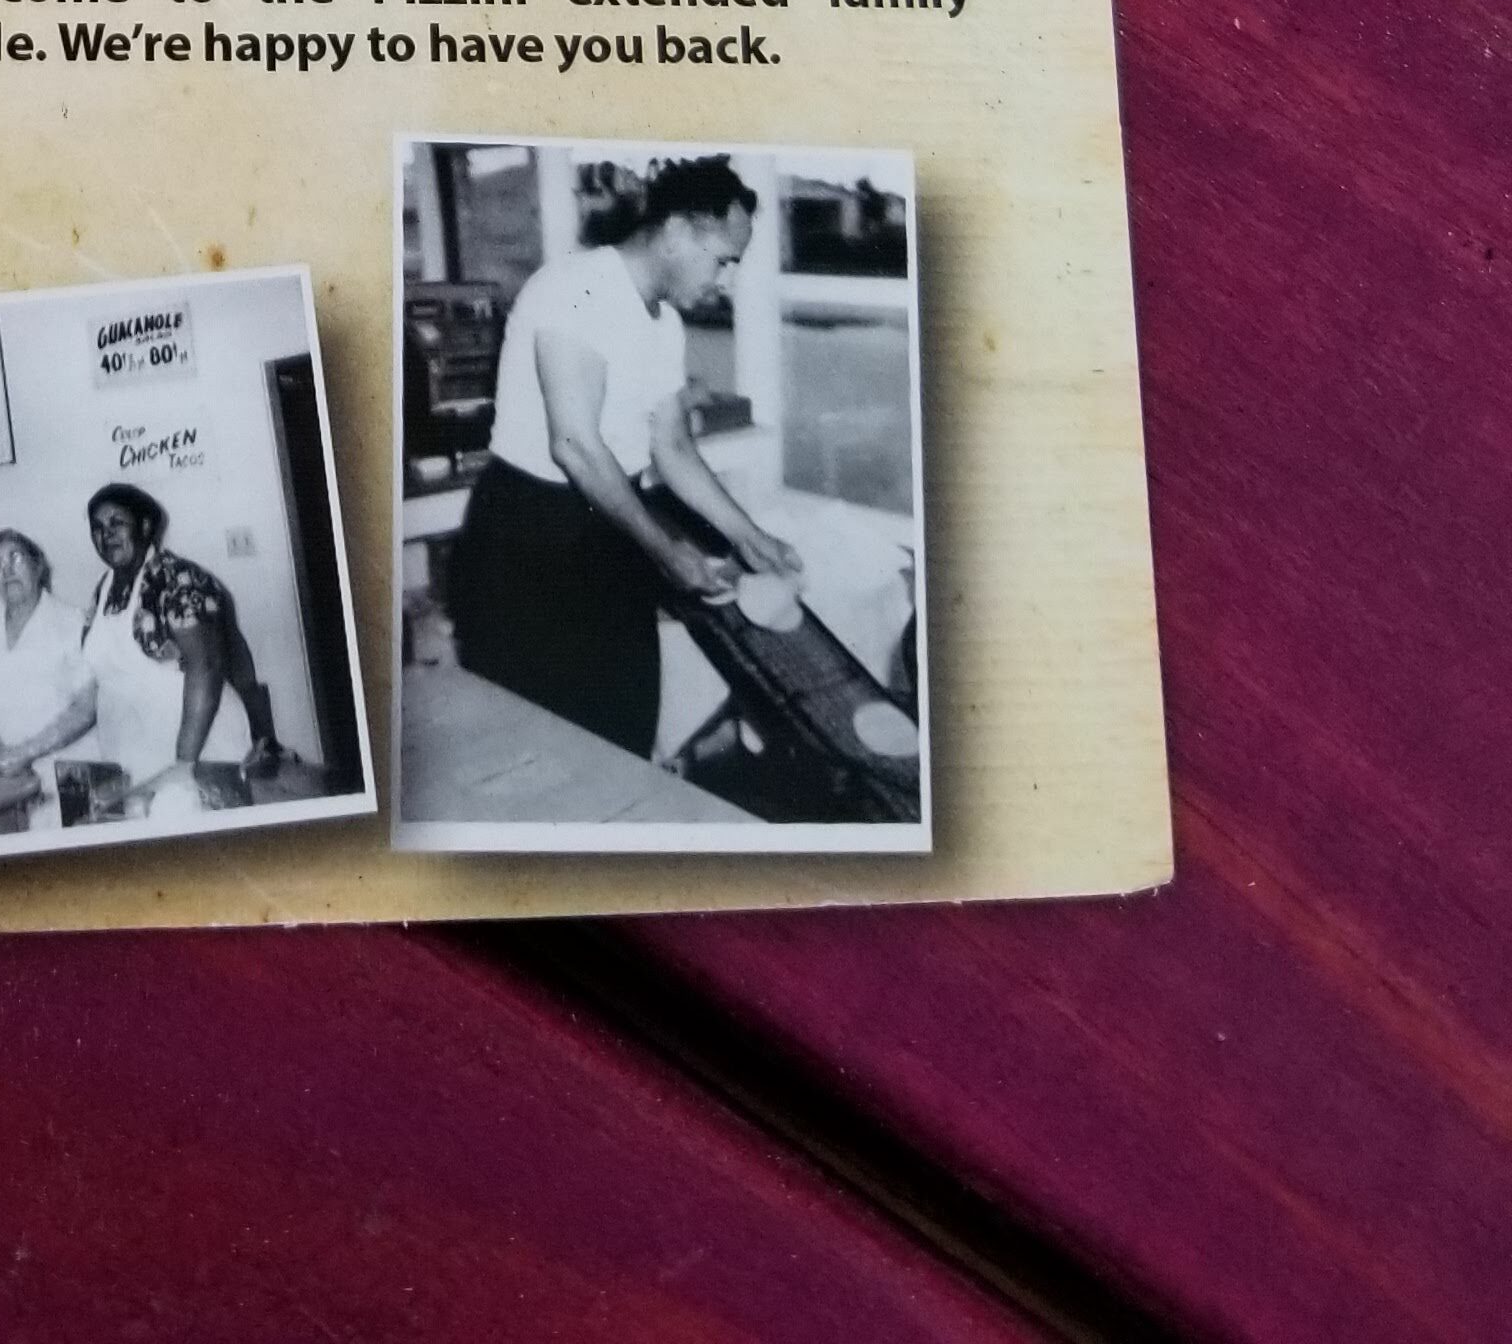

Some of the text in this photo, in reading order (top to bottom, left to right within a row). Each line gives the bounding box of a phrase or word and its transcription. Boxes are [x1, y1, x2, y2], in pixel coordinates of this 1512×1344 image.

[58, 23, 191, 62] We're
[204, 22, 355, 72] happy
[367, 27, 415, 62] to
[430, 23, 544, 63] have
[554, 35, 643, 74] you
[657, 25, 781, 65] back.
[119, 428, 197, 469] CHICKEN
